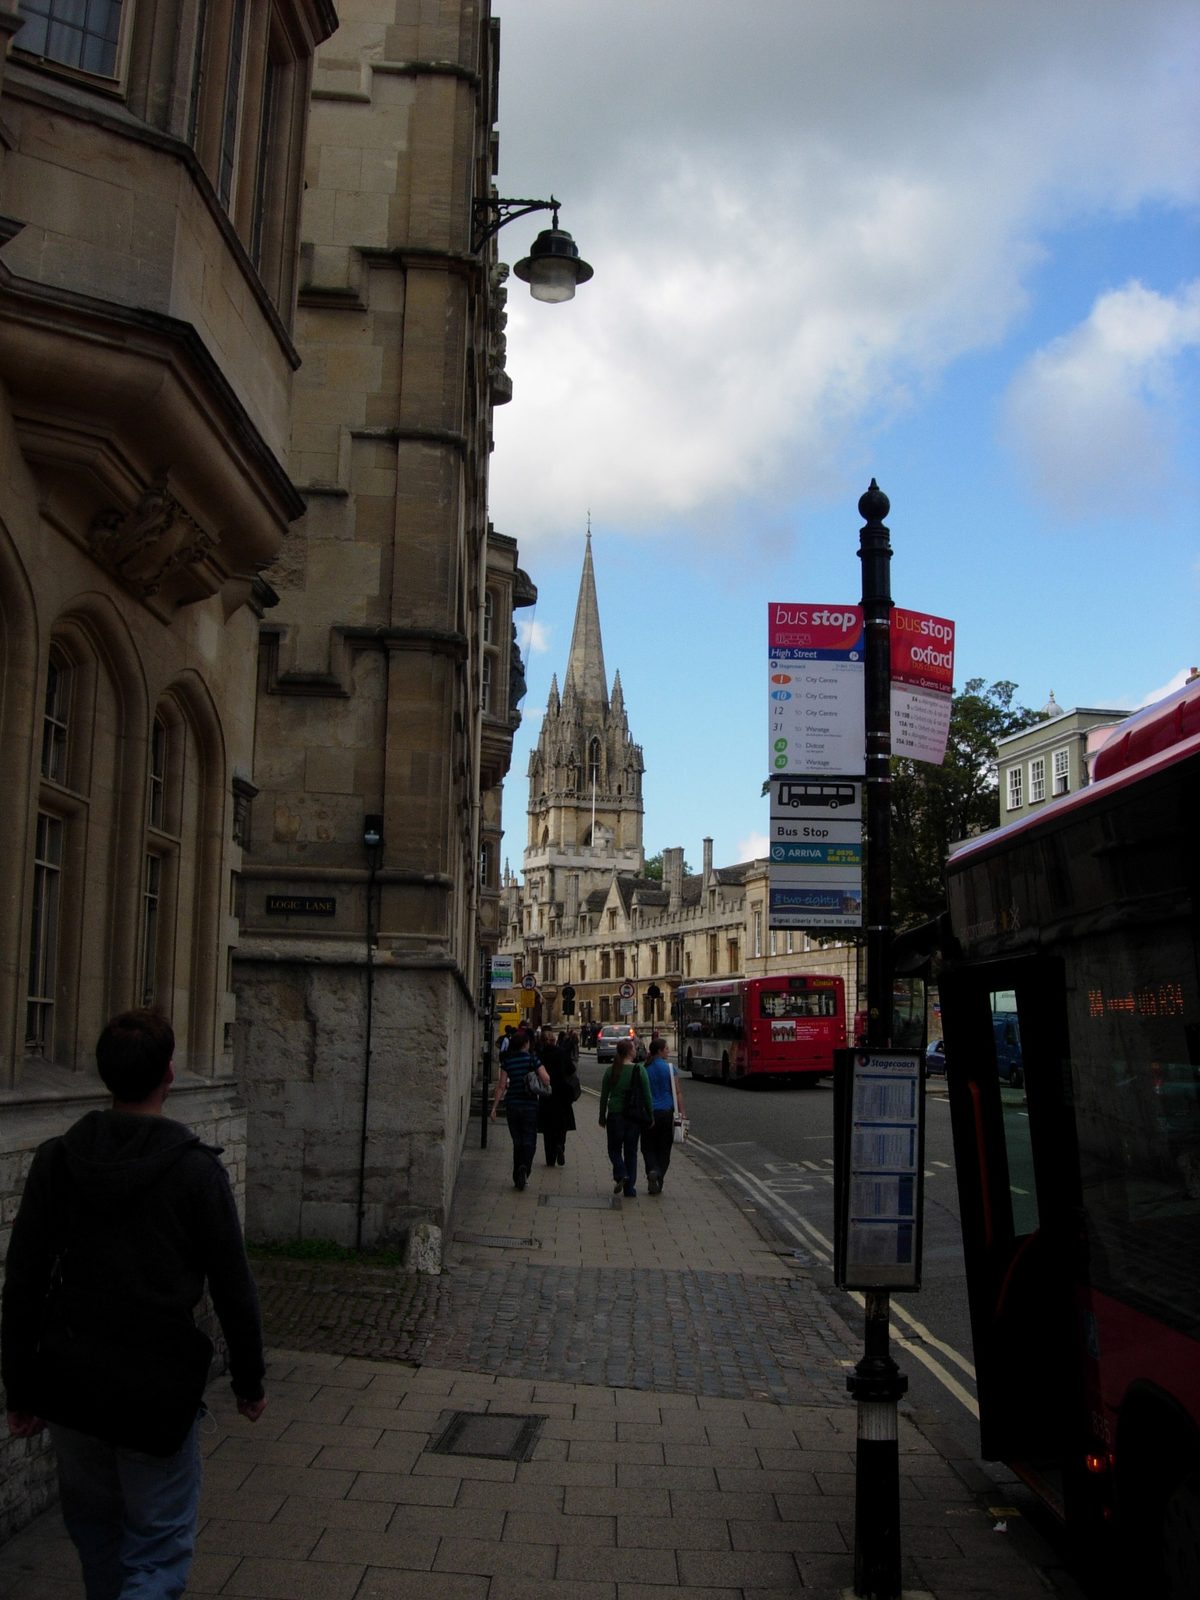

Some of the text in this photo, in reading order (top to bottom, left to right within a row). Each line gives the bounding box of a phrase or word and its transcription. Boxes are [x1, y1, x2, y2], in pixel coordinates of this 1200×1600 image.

[775, 605, 857, 632] bus stop
[771, 649, 817, 660] High Street
[911, 646, 953, 669] oxford
[774, 706, 784, 715] 12
[773, 723, 783, 731] 31
[777, 826, 829, 838] Bus Stop
[788, 849, 822, 857] ARRIVA
[271, 900, 333, 911] LOGIC LANE
[870, 1059, 915, 1070] Stagecoach
